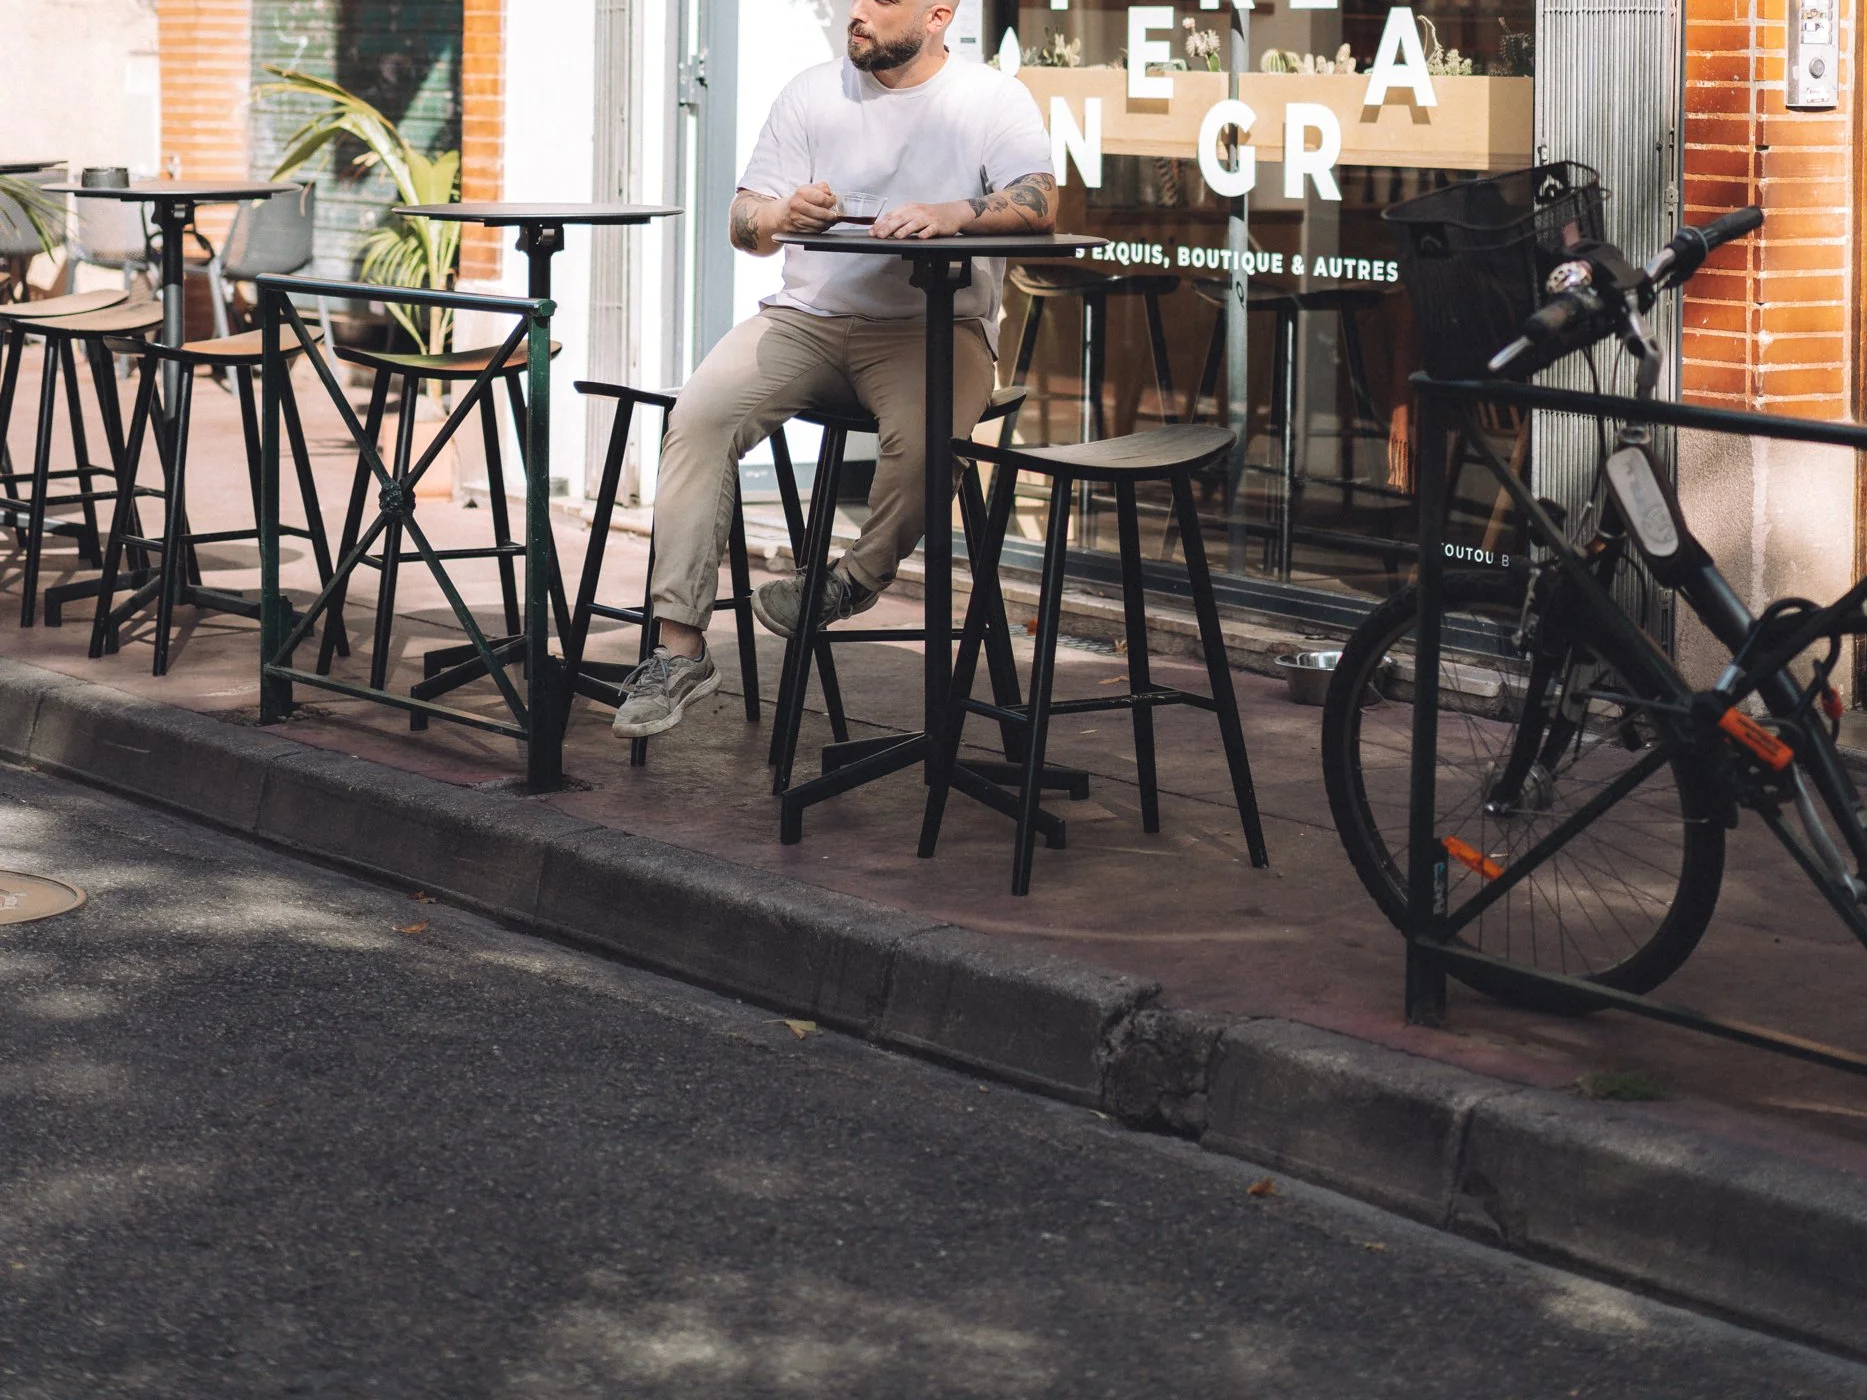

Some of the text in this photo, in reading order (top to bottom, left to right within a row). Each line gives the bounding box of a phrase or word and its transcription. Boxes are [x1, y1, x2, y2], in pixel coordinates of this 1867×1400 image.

[1091, 241, 1170, 269] EXQUIS,
[1177, 246, 1283, 275] BOUTIQUE
[1291, 253, 1305, 275] &
[1313, 256, 1399, 283] AUTRES
[1441, 542, 1494, 565] OUTOU
